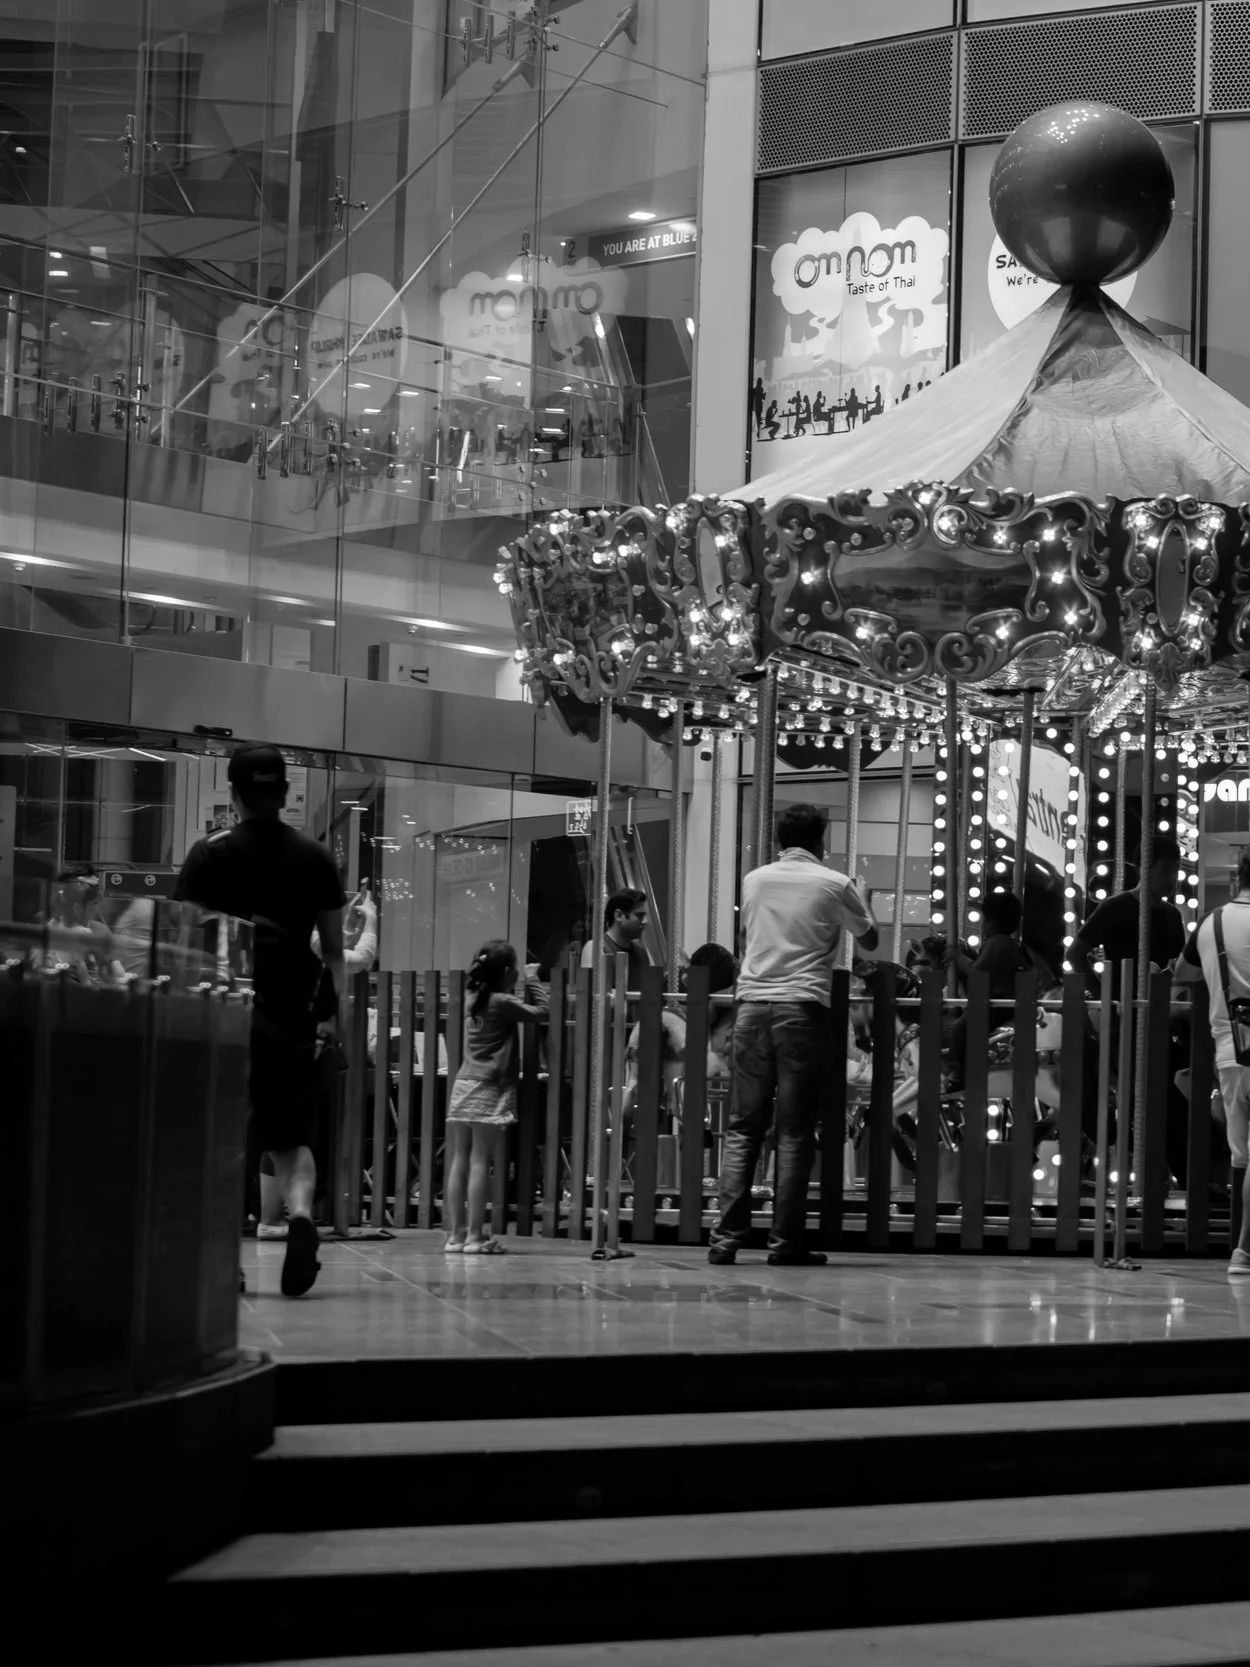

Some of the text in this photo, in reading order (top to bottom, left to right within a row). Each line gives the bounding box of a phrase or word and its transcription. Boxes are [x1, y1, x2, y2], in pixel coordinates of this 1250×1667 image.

[602, 241, 623, 256] YOU
[624, 237, 647, 253] ARE
[647, 235, 662, 249] AT
[662, 231, 690, 247] BLUE
[847, 275, 916, 296] Taste of Thai
[1006, 274, 1039, 287] We're
